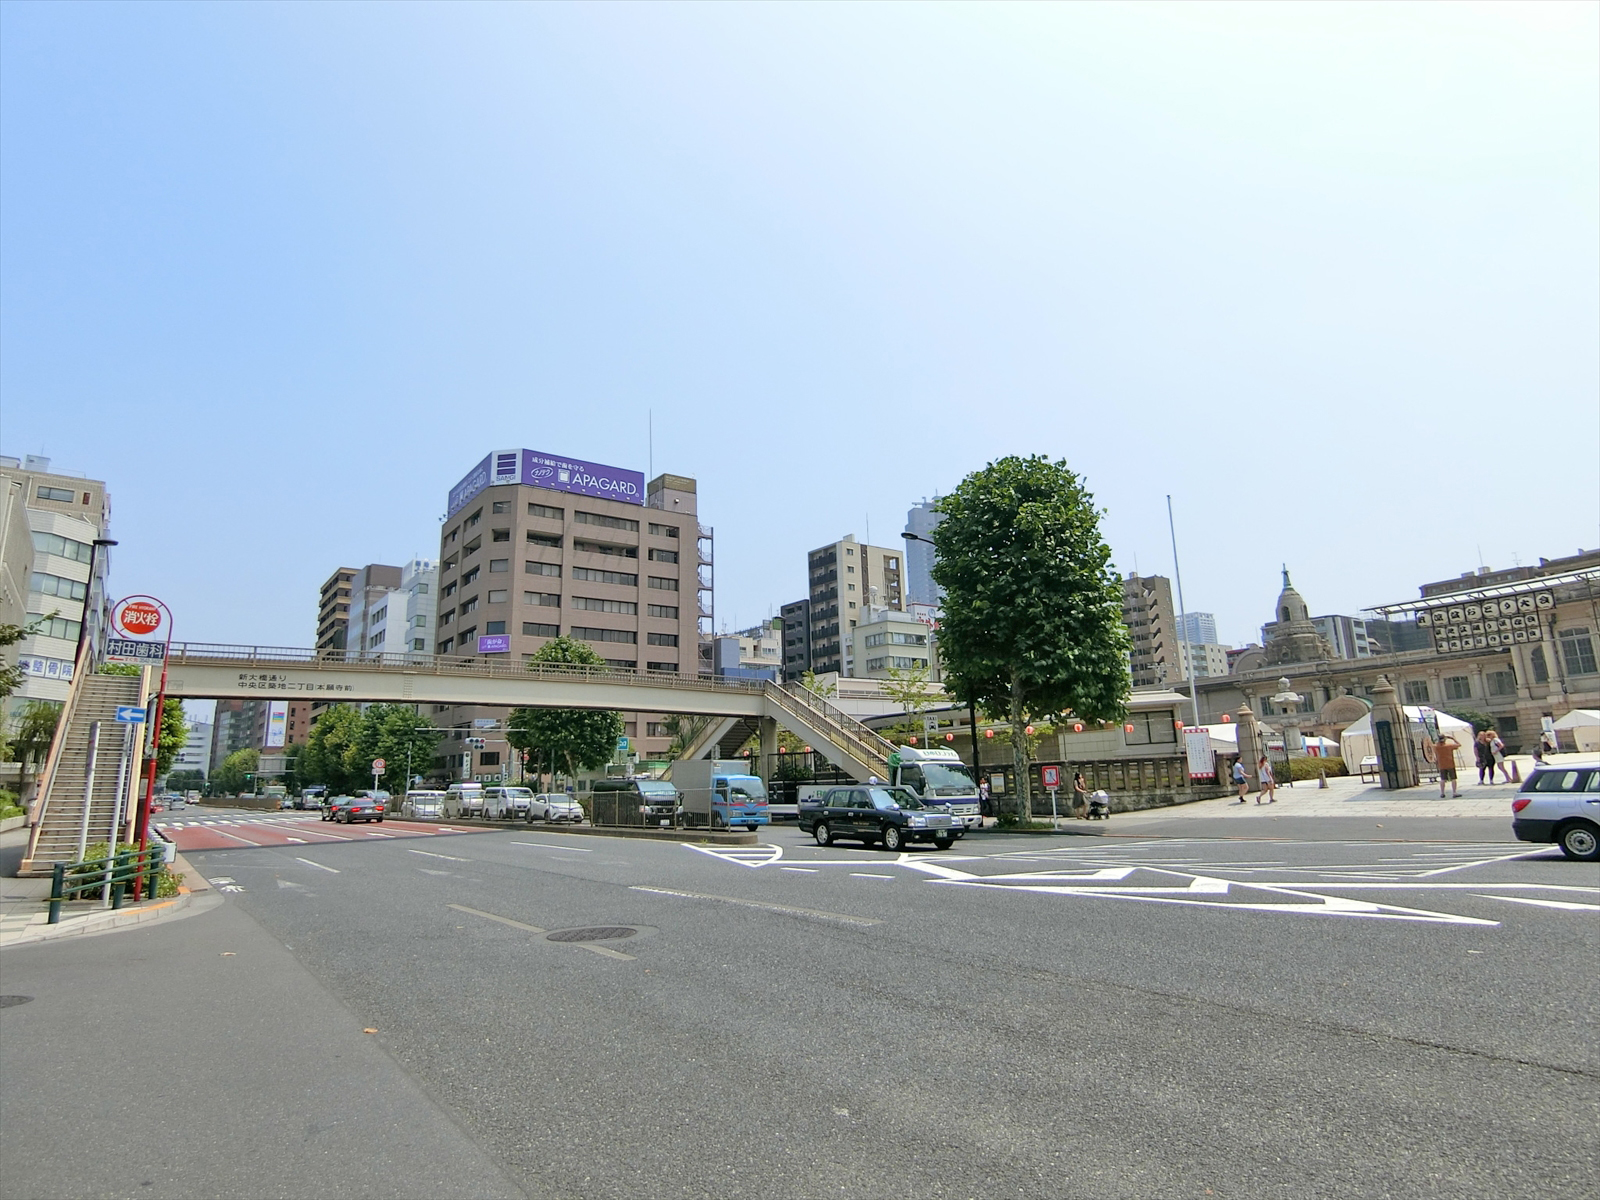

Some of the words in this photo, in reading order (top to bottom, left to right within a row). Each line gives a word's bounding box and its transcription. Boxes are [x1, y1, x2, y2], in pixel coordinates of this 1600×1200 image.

[572, 473, 637, 495] APAGARD
[123, 610, 159, 626] 消火栓
[108, 640, 163, 658] 村田歯科
[239, 673, 287, 682] 新大橋通り
[238, 681, 355, 692] 中央区築地二丁目(本願寺前)
